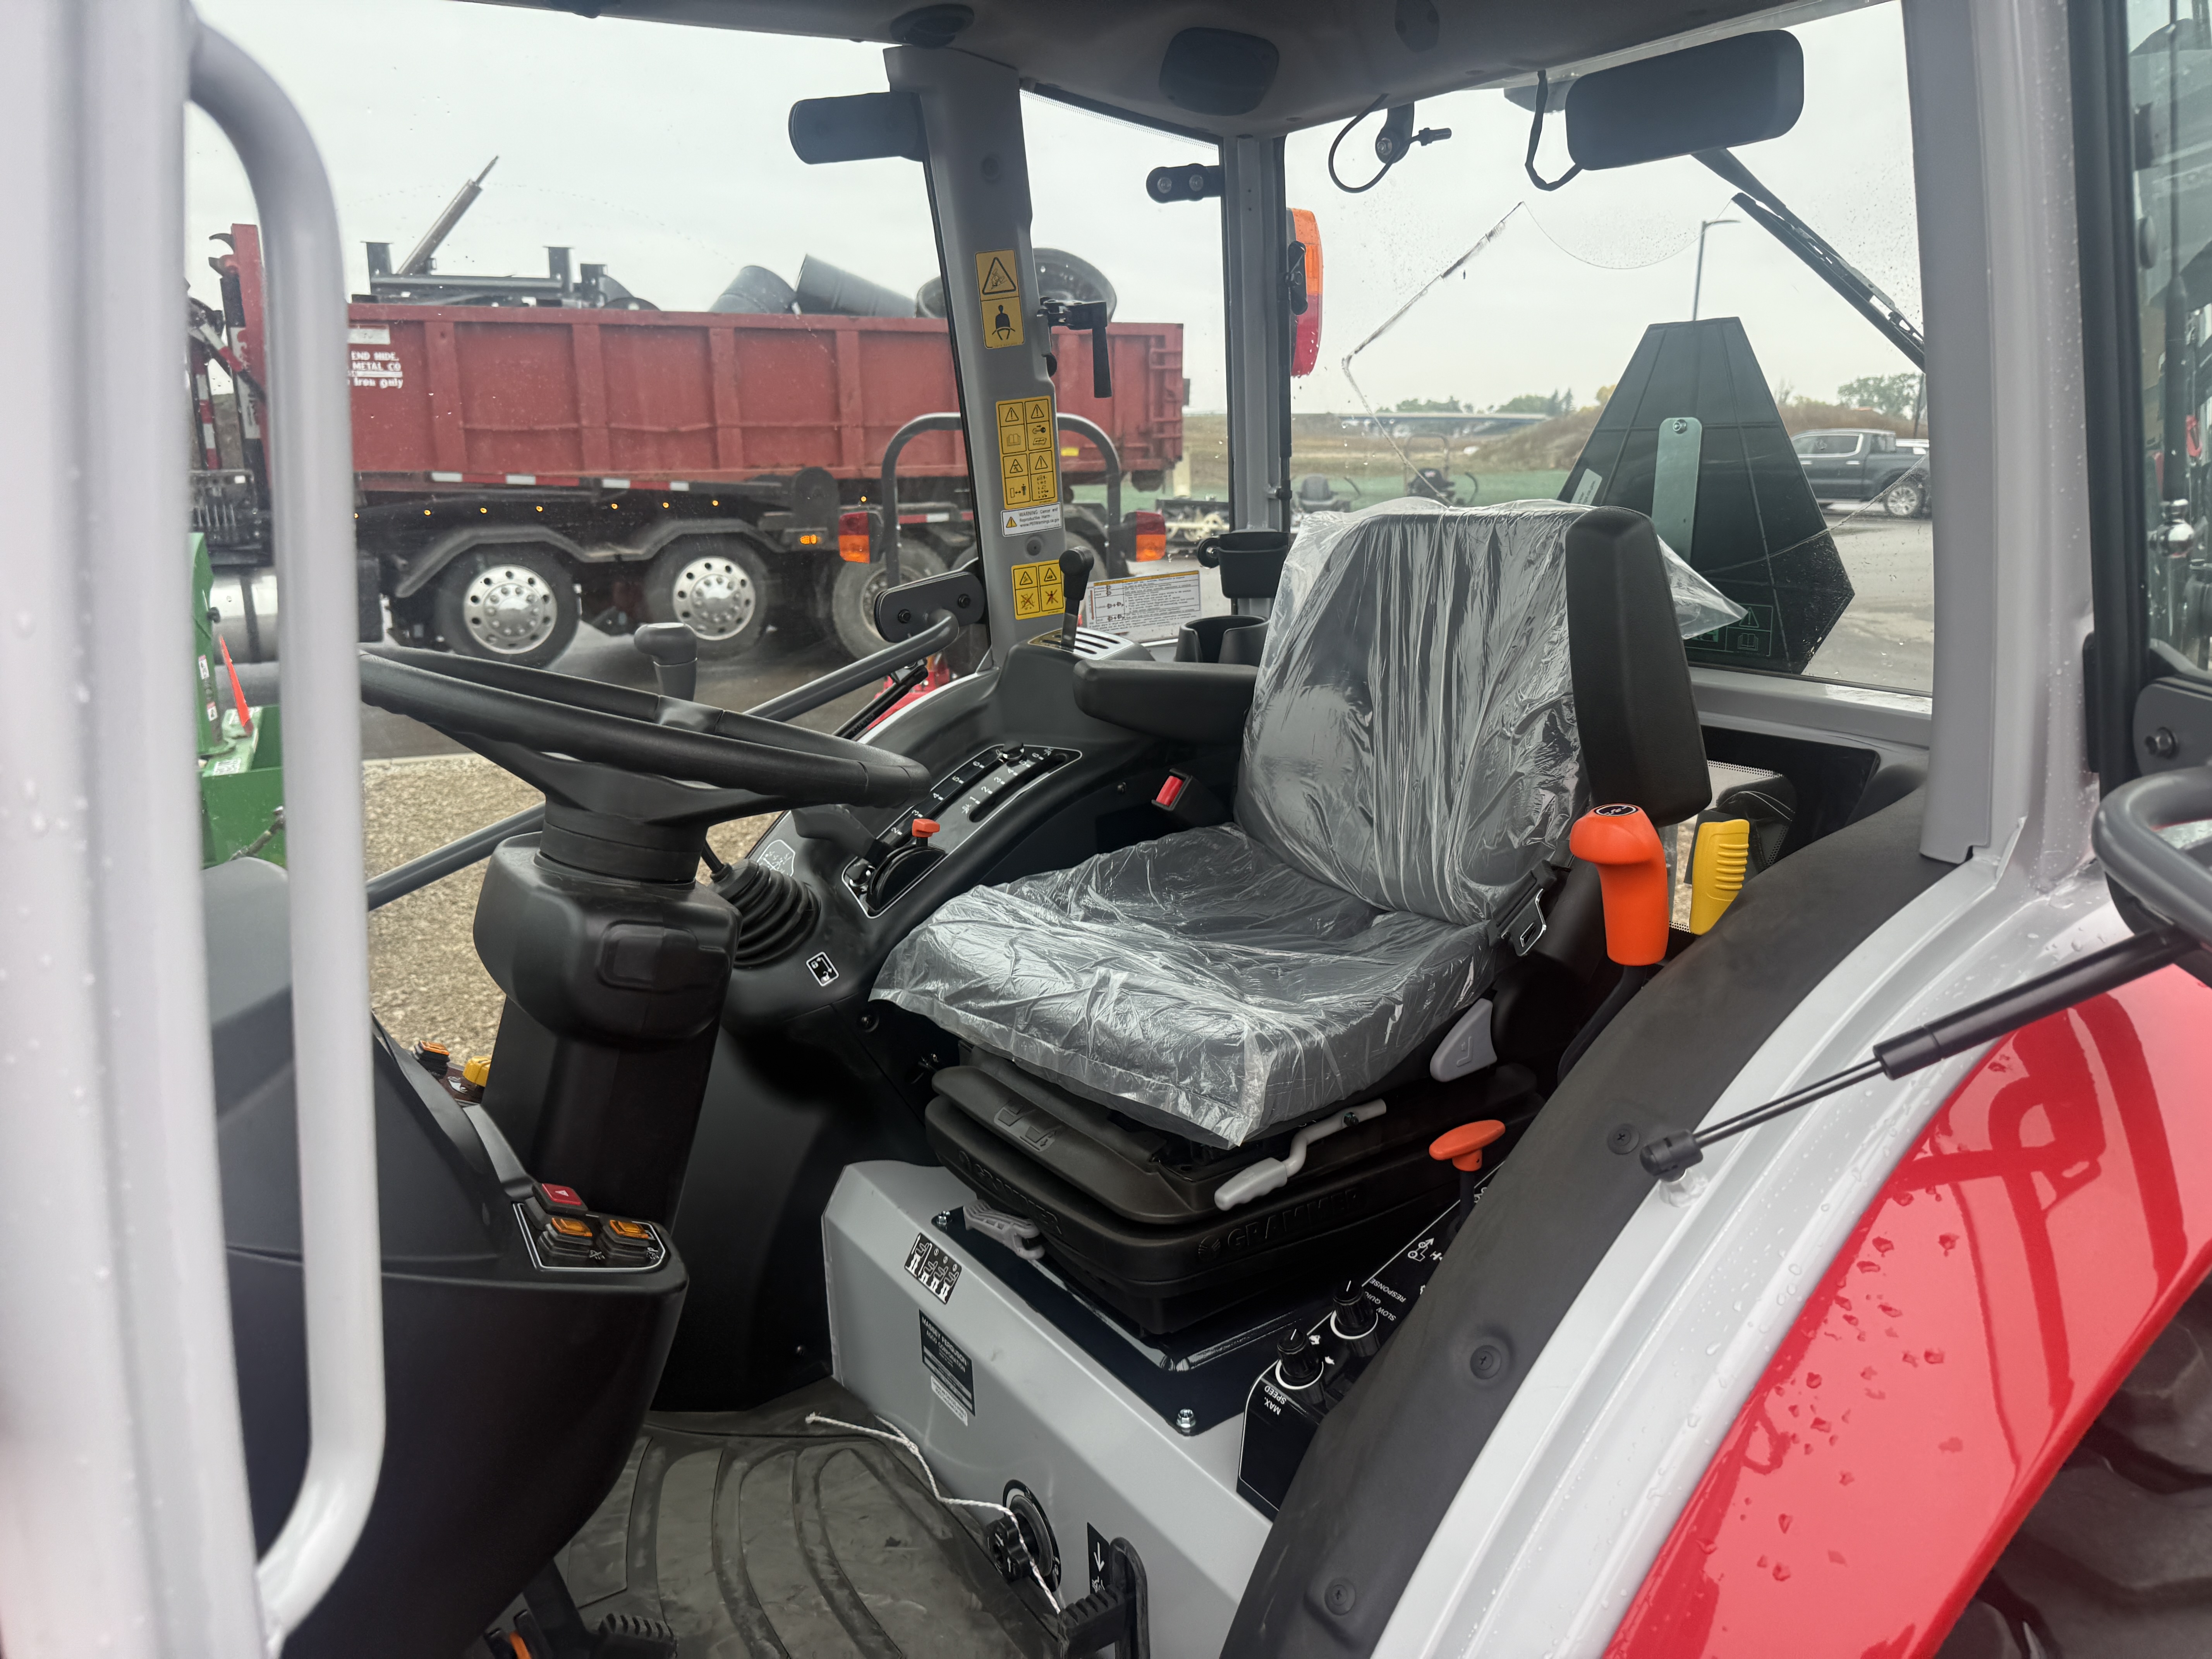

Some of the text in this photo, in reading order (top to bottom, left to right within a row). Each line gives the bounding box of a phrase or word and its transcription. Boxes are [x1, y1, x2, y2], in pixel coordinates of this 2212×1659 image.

[352, 361, 384, 371] METAL
[1365, 1291, 1381, 1304] QUIC
[1369, 1278, 1407, 1303] RESPONSE
[1376, 1307, 1396, 1321] SLOW
[938, 1341, 965, 1372] CORPORATION
[941, 1336, 967, 1366] FERGUSON
[1264, 1385, 1286, 1405] SPEED
[1264, 1397, 1281, 1415] MAX.
